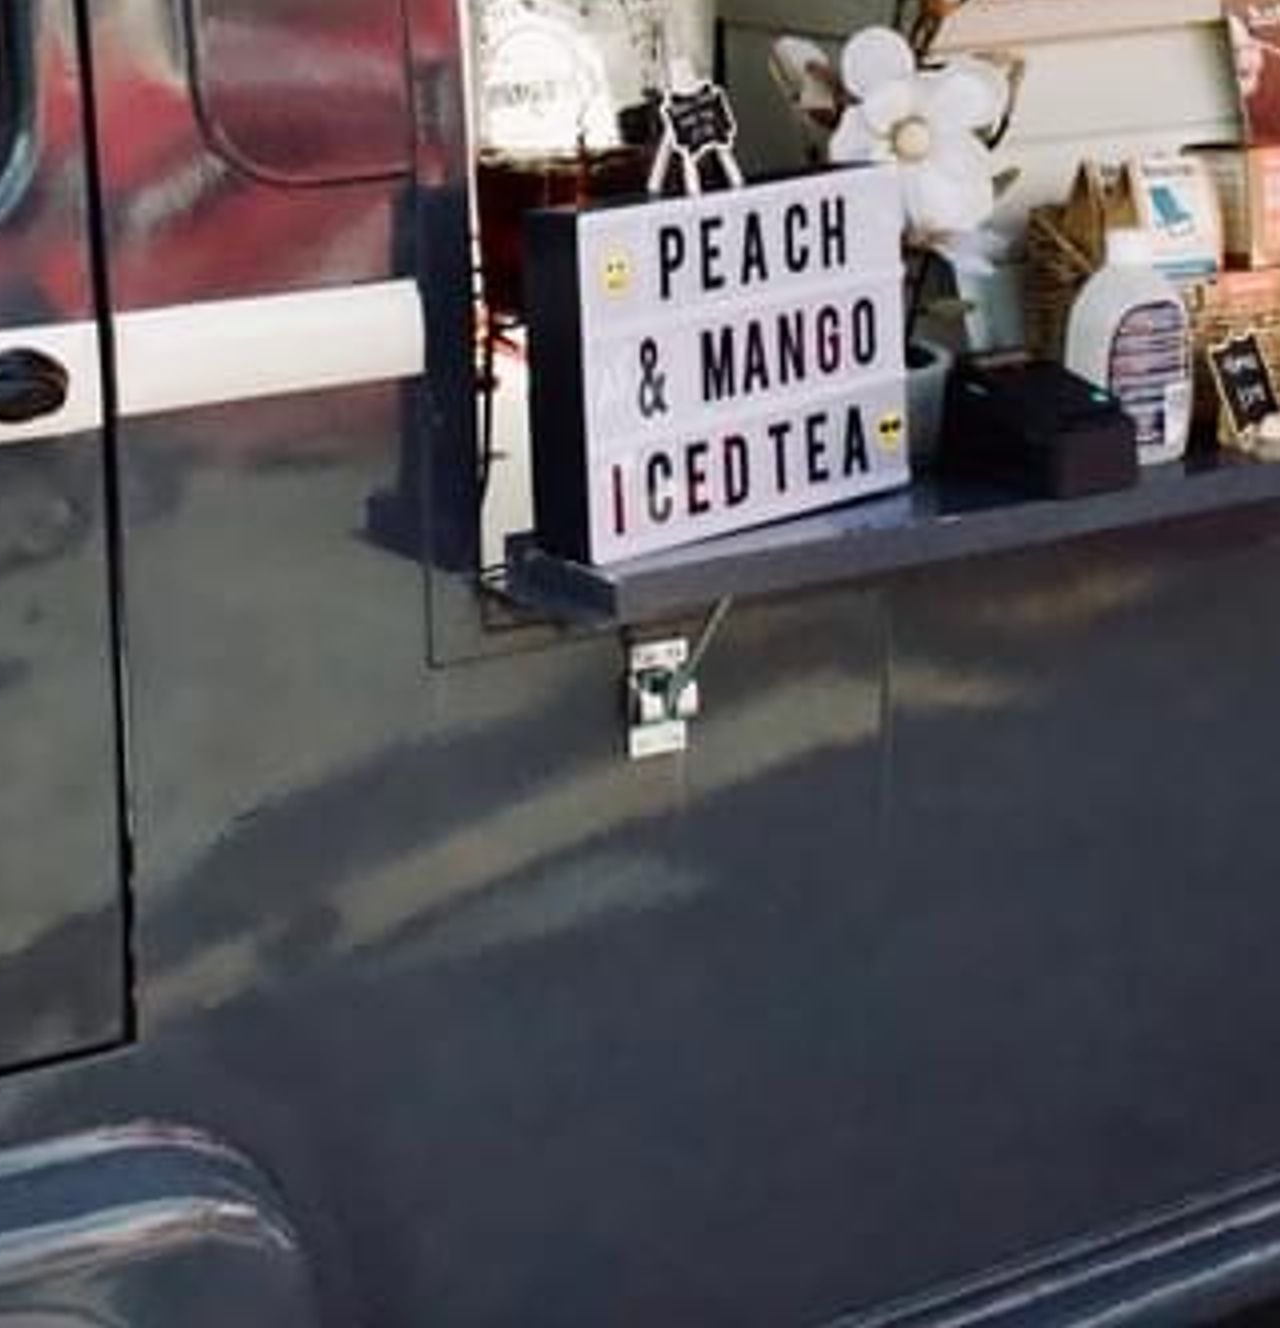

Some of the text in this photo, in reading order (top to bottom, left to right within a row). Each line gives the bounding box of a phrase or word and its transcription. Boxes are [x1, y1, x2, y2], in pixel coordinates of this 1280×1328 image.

[658, 195, 847, 301] PEACH
[638, 297, 877, 420] & MANGO
[611, 403, 870, 536] ICED TEA
